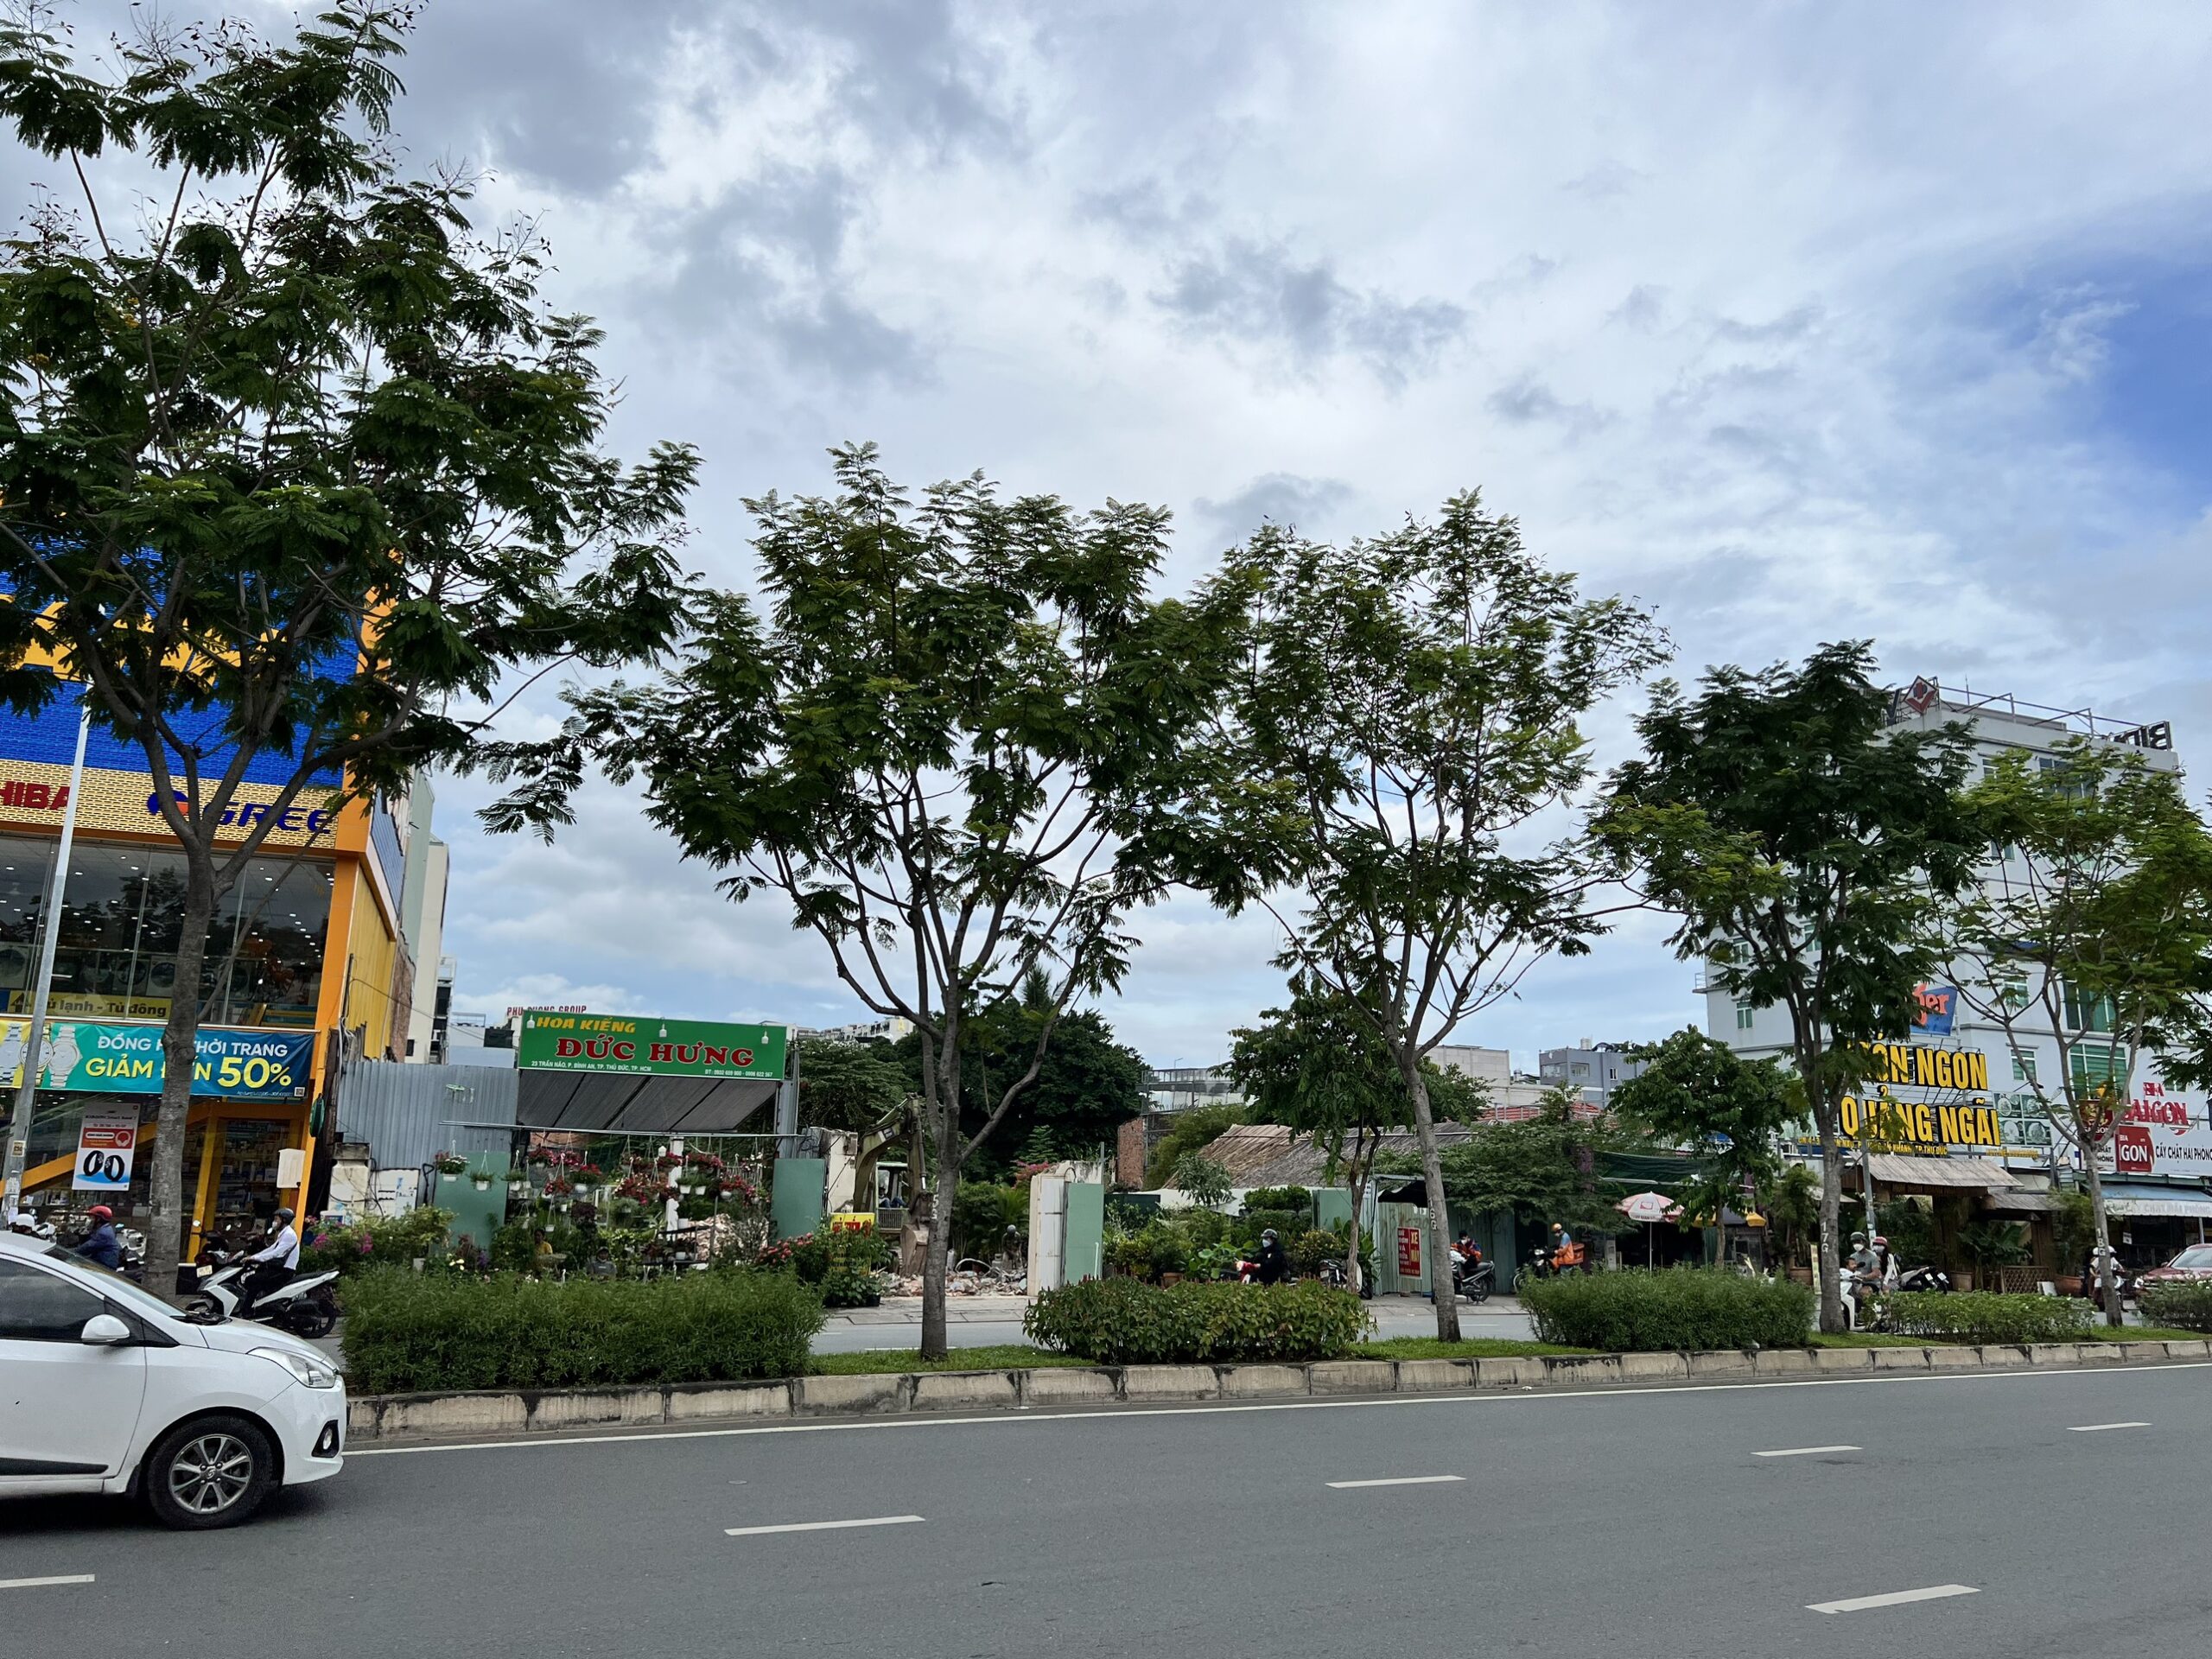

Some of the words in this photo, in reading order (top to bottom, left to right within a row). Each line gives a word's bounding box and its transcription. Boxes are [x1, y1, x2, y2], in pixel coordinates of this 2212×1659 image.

[60, 1000, 93, 1013] lạnh
[128, 1001, 167, 1017] đông
[537, 1016, 575, 1028] HOA
[580, 1015, 636, 1033] KIẾNG
[231, 1042, 288, 1057] TRANG
[555, 1033, 636, 1061] ĐỨC
[647, 1041, 754, 1068] HƯNG
[85, 1053, 154, 1079] GIẢM
[217, 1056, 292, 1089] 50%
[1915, 1047, 1988, 1090] NGON
[1937, 1097, 2001, 1146] NGÃI
[1821, 1221, 1829, 1253] 17G
